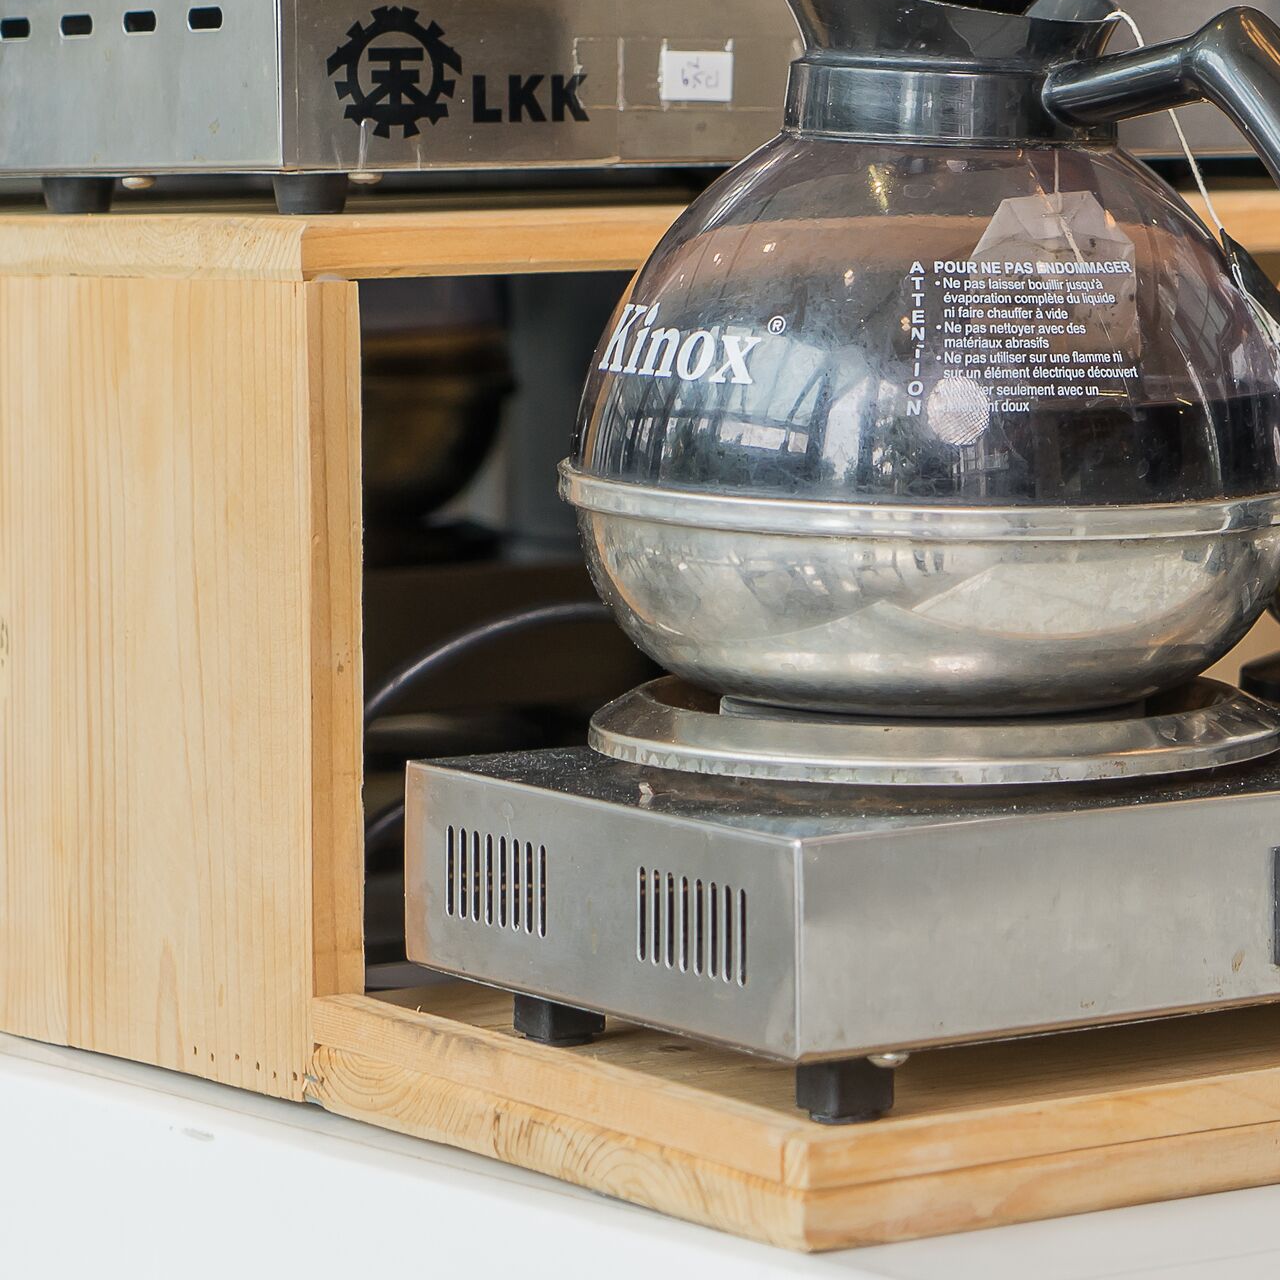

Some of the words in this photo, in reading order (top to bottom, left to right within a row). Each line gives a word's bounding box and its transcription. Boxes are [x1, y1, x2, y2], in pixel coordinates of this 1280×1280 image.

[472, 74, 589, 123] LKK
[934, 261, 977, 274] POUR
[980, 262, 1001, 274] NE
[1005, 262, 1033, 274] PAS
[1037, 262, 1132, 274] ENDOMMAGER
[943, 278, 960, 288] Ne
[964, 280, 985, 290] pas
[989, 279, 1025, 290] laisser
[1029, 279, 1063, 290] bouillir
[1066, 279, 1103, 292] jusqu'à
[944, 292, 1011, 305] évaporation
[1014, 293, 1064, 305] complète
[1067, 294, 1079, 304] du
[1082, 294, 1116, 305] liquide
[944, 308, 955, 318] ni
[958, 307, 983, 319] faire
[987, 308, 1033, 319] chauffer
[1036, 307, 1043, 319] à
[1046, 309, 1068, 319] vide
[944, 323, 962, 333] Ne
[965, 324, 986, 335] pas
[989, 323, 1035, 336] nettoyer
[1039, 325, 1064, 334] avec
[1066, 323, 1086, 334] des
[598, 302, 762, 384] Kinox
[944, 337, 1002, 348] matériaux
[1006, 338, 1049, 349] abrasifs
[944, 352, 962, 363] Ne
[965, 354, 986, 365] pas
[990, 351, 1026, 363] utiliser
[1029, 354, 1046, 363] sur
[1050, 354, 1070, 363] une
[1072, 351, 1110, 363] flamme
[1113, 352, 1123, 362] ni
[966, 369, 980, 379] un
[984, 367, 1030, 379] élément
[1033, 367, 1085, 381] électrique
[1088, 367, 1138, 378] découvert
[996, 384, 1054, 396] seulement
[1057, 387, 1083, 396] avec
[1086, 386, 1099, 395] un
[1002, 401, 1029, 412] doux
